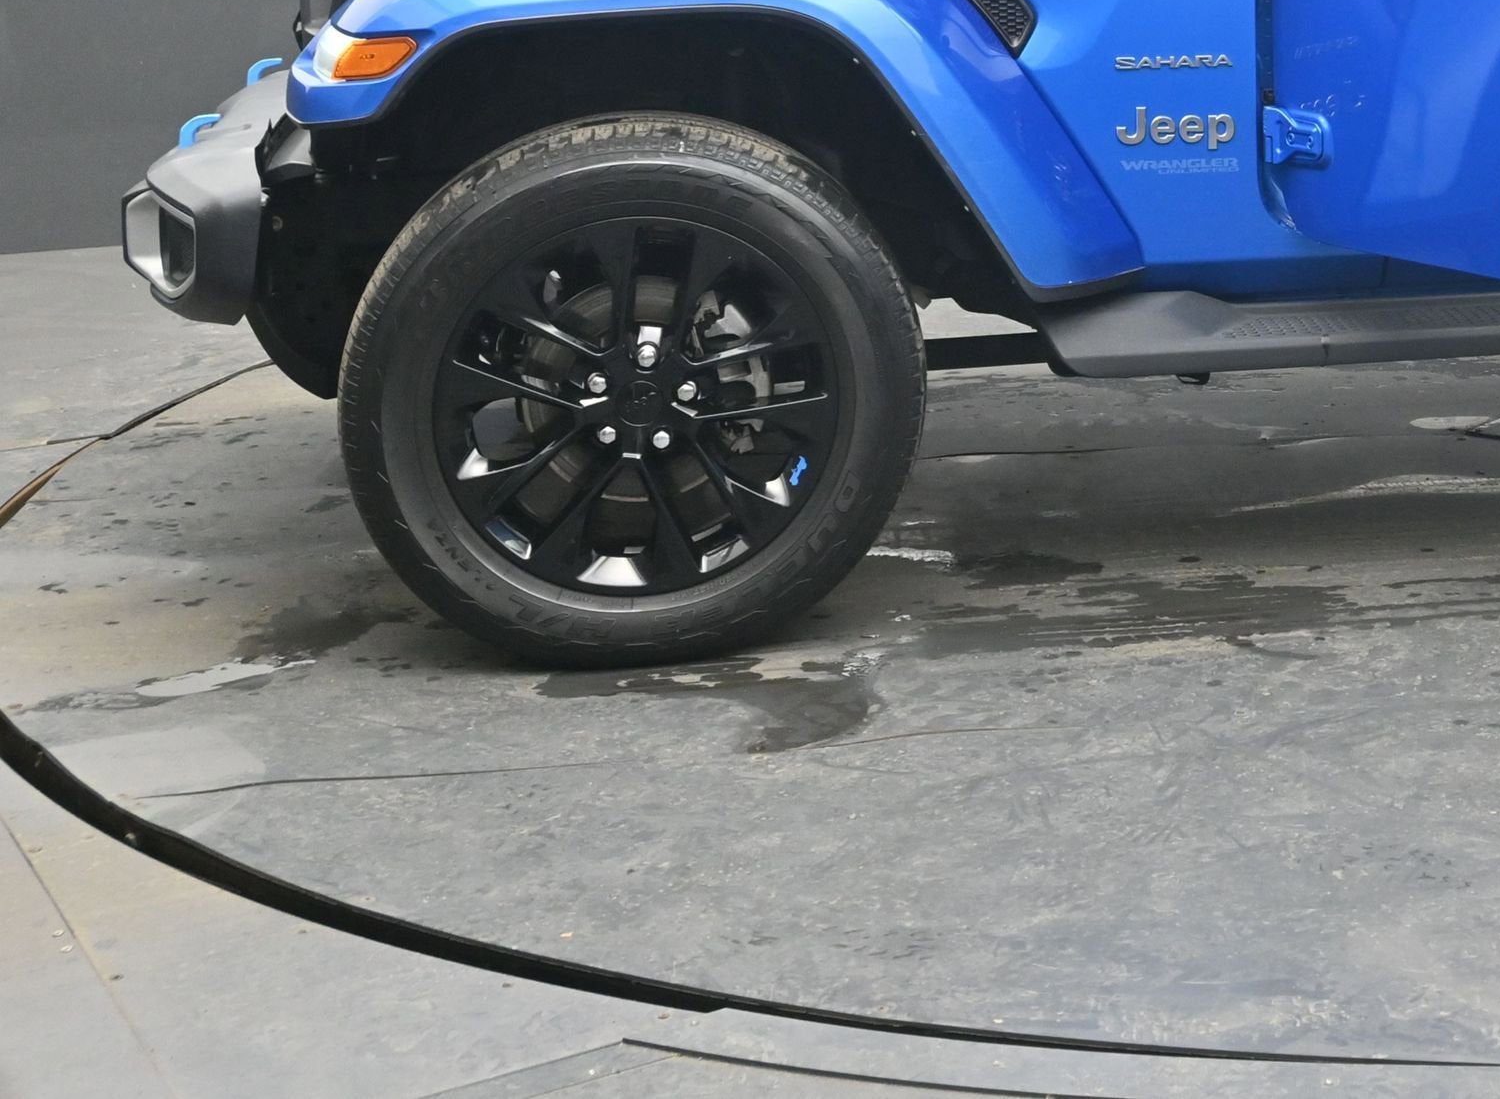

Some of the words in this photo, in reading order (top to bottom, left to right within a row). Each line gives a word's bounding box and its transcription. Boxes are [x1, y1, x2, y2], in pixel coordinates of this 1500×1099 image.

[1115, 54, 1233, 70] SAHARA
[1116, 106, 1235, 150] Jeep
[1120, 157, 1239, 171] WRANGLER
[1158, 166, 1240, 175] UNLIMITED
